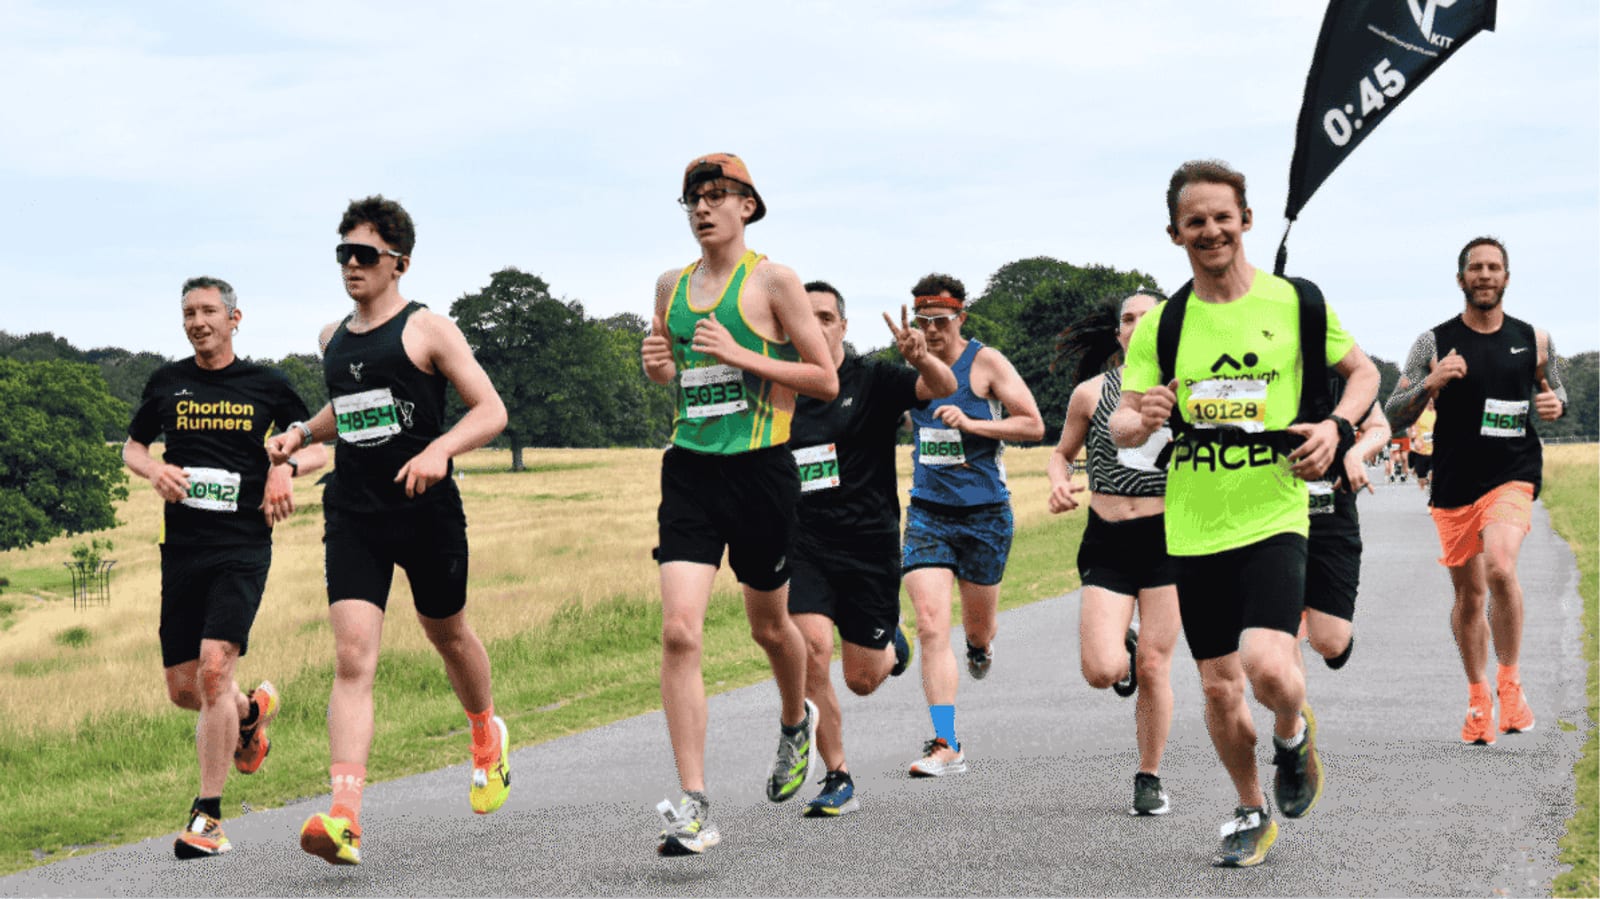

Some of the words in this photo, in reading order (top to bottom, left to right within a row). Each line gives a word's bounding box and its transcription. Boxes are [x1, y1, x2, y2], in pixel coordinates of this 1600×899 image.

[1430, 33, 1454, 49] KIT
[1323, 58, 1406, 146] 0:45
[685, 381, 743, 407] 5033
[176, 400, 254, 416] Chorlton
[1194, 402, 1257, 420] 10128
[176, 417, 253, 431] Runners
[339, 405, 395, 430] 4854
